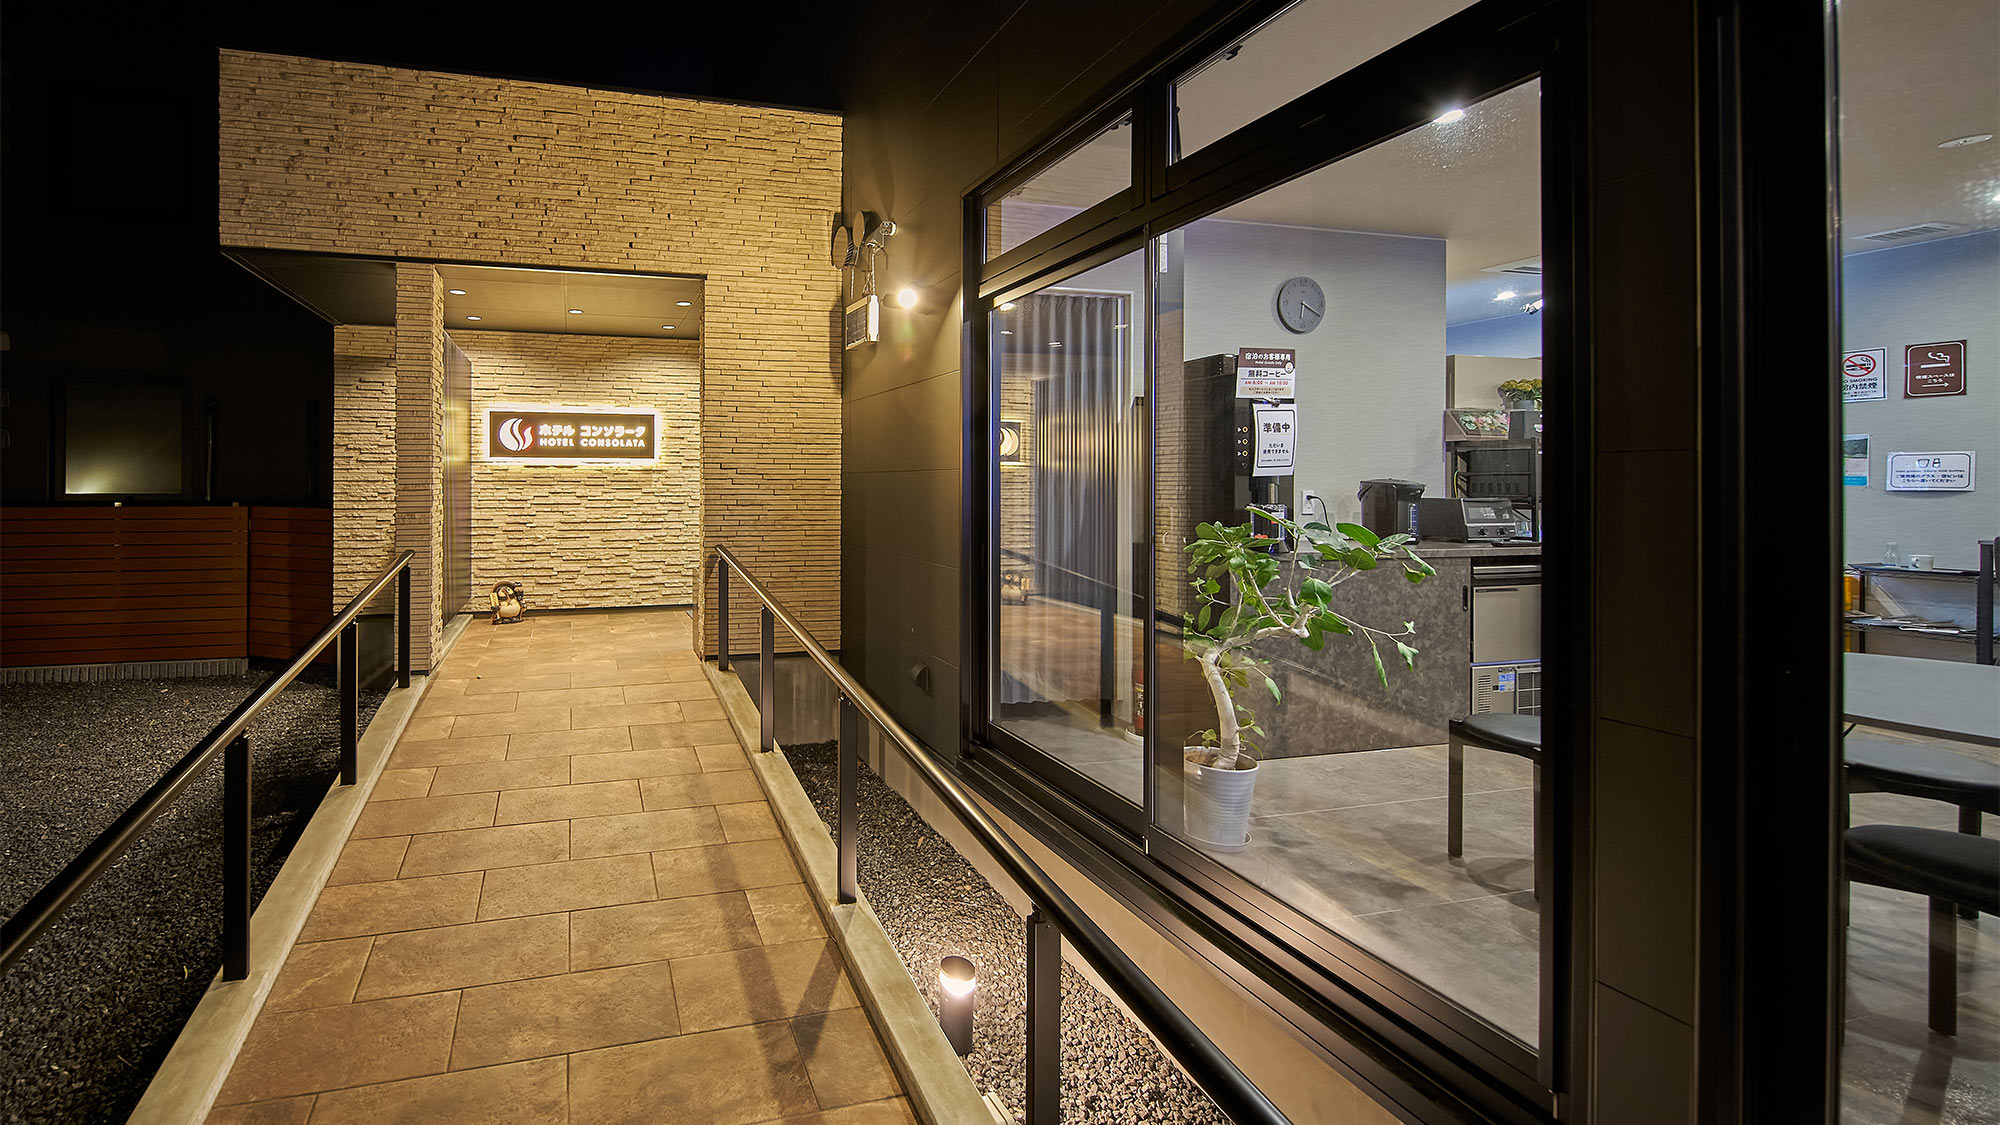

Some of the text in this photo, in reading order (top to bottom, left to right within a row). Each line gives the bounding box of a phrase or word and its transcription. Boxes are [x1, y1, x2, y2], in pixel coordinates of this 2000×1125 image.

[539, 424, 575, 436] ホテル
[1264, 422, 1290, 433] 準備中
[539, 438, 645, 447] HOTEL CONSOLATA
